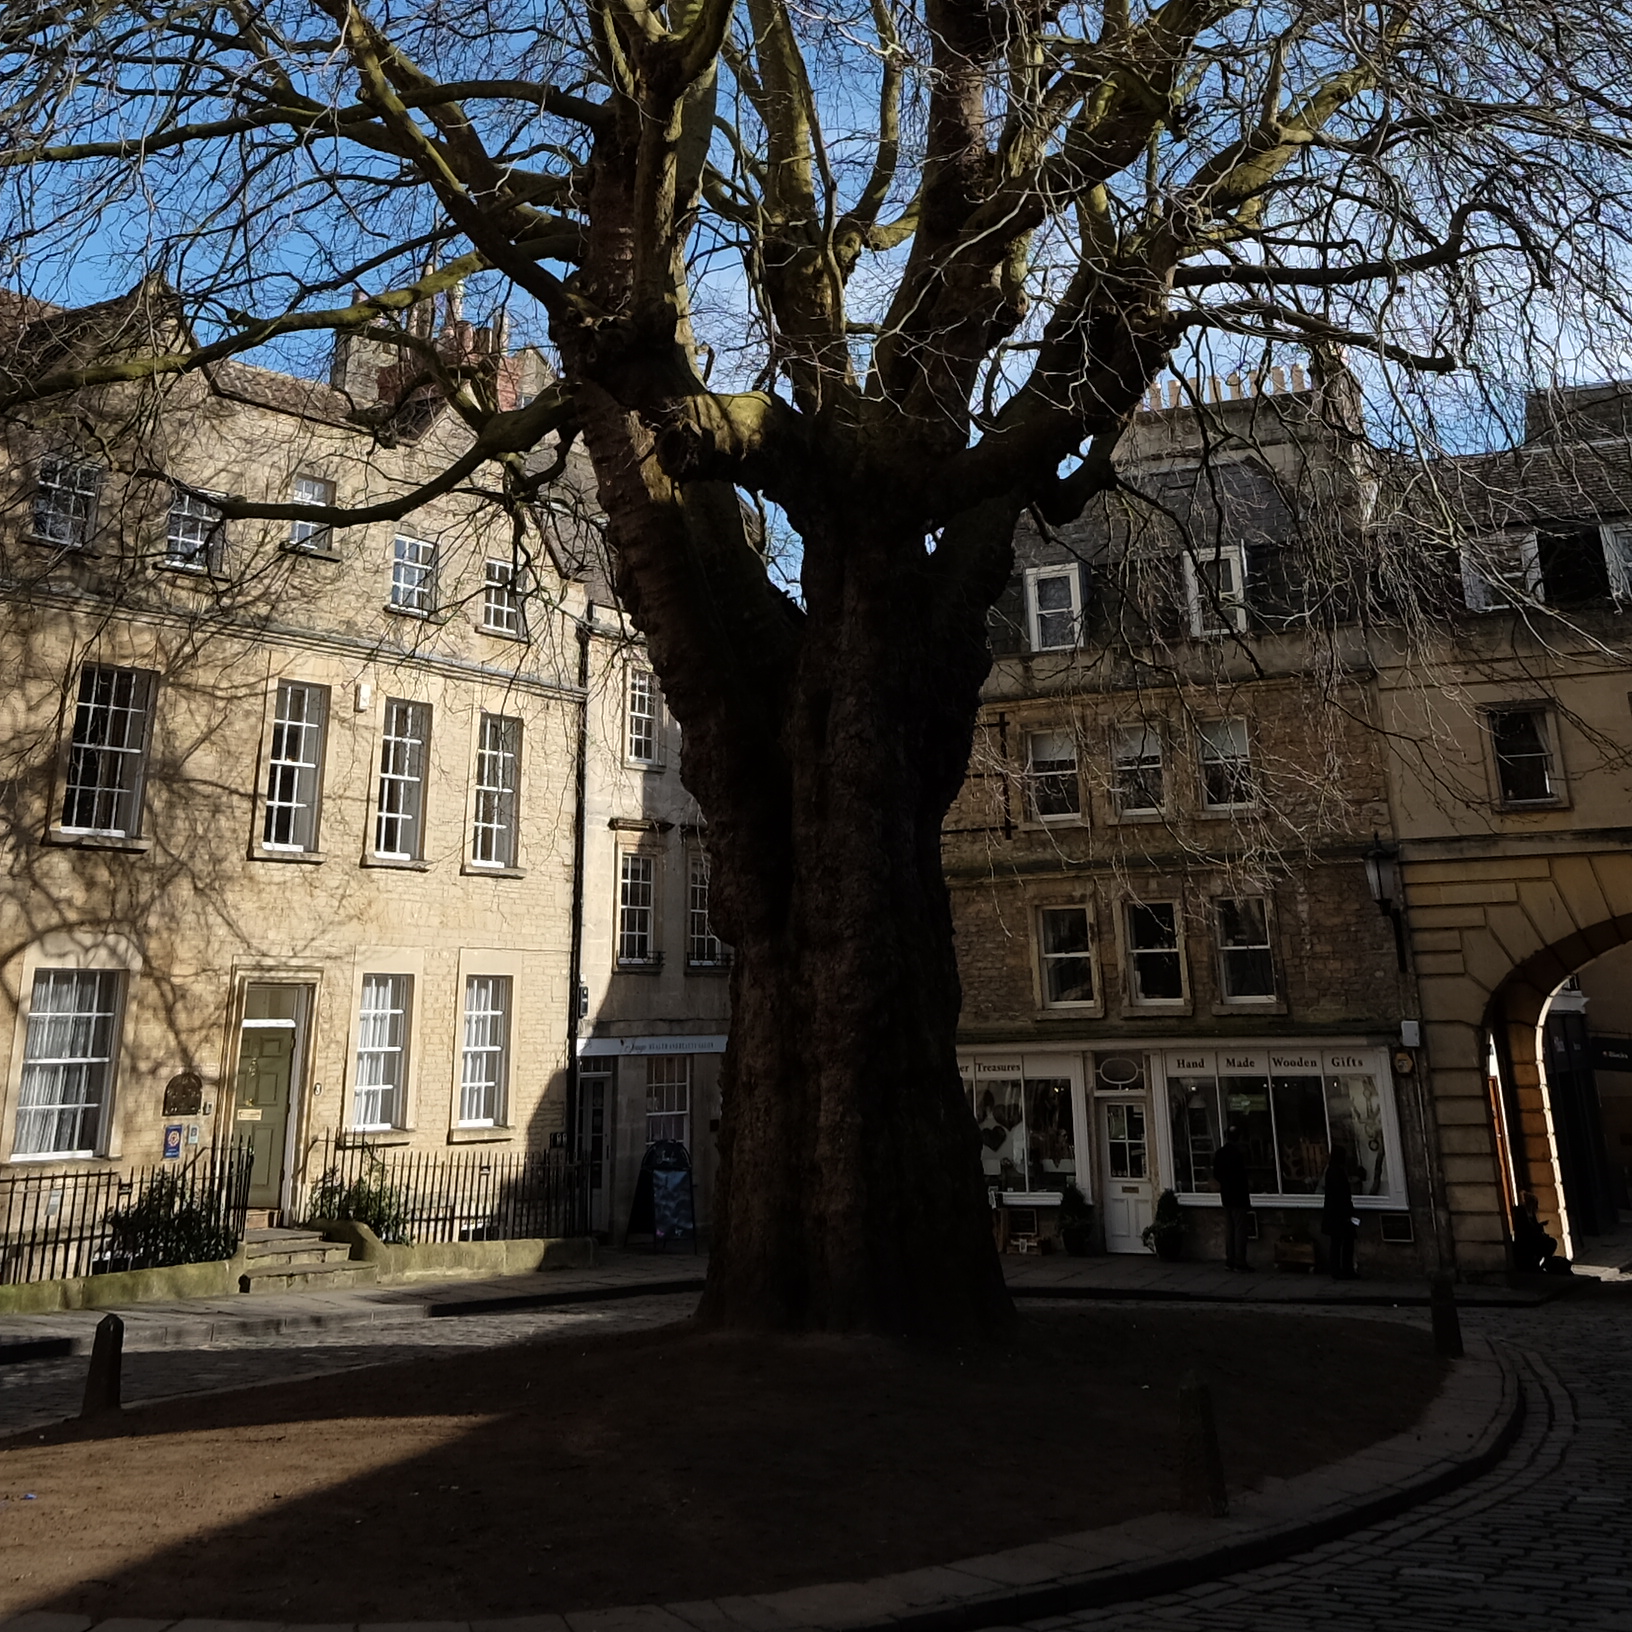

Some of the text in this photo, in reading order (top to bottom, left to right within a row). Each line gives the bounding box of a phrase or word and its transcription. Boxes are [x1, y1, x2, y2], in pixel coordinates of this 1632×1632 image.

[975, 1062, 1021, 1073] Treasures
[1177, 1056, 1363, 1069] Hand Made Wooden Gifts
